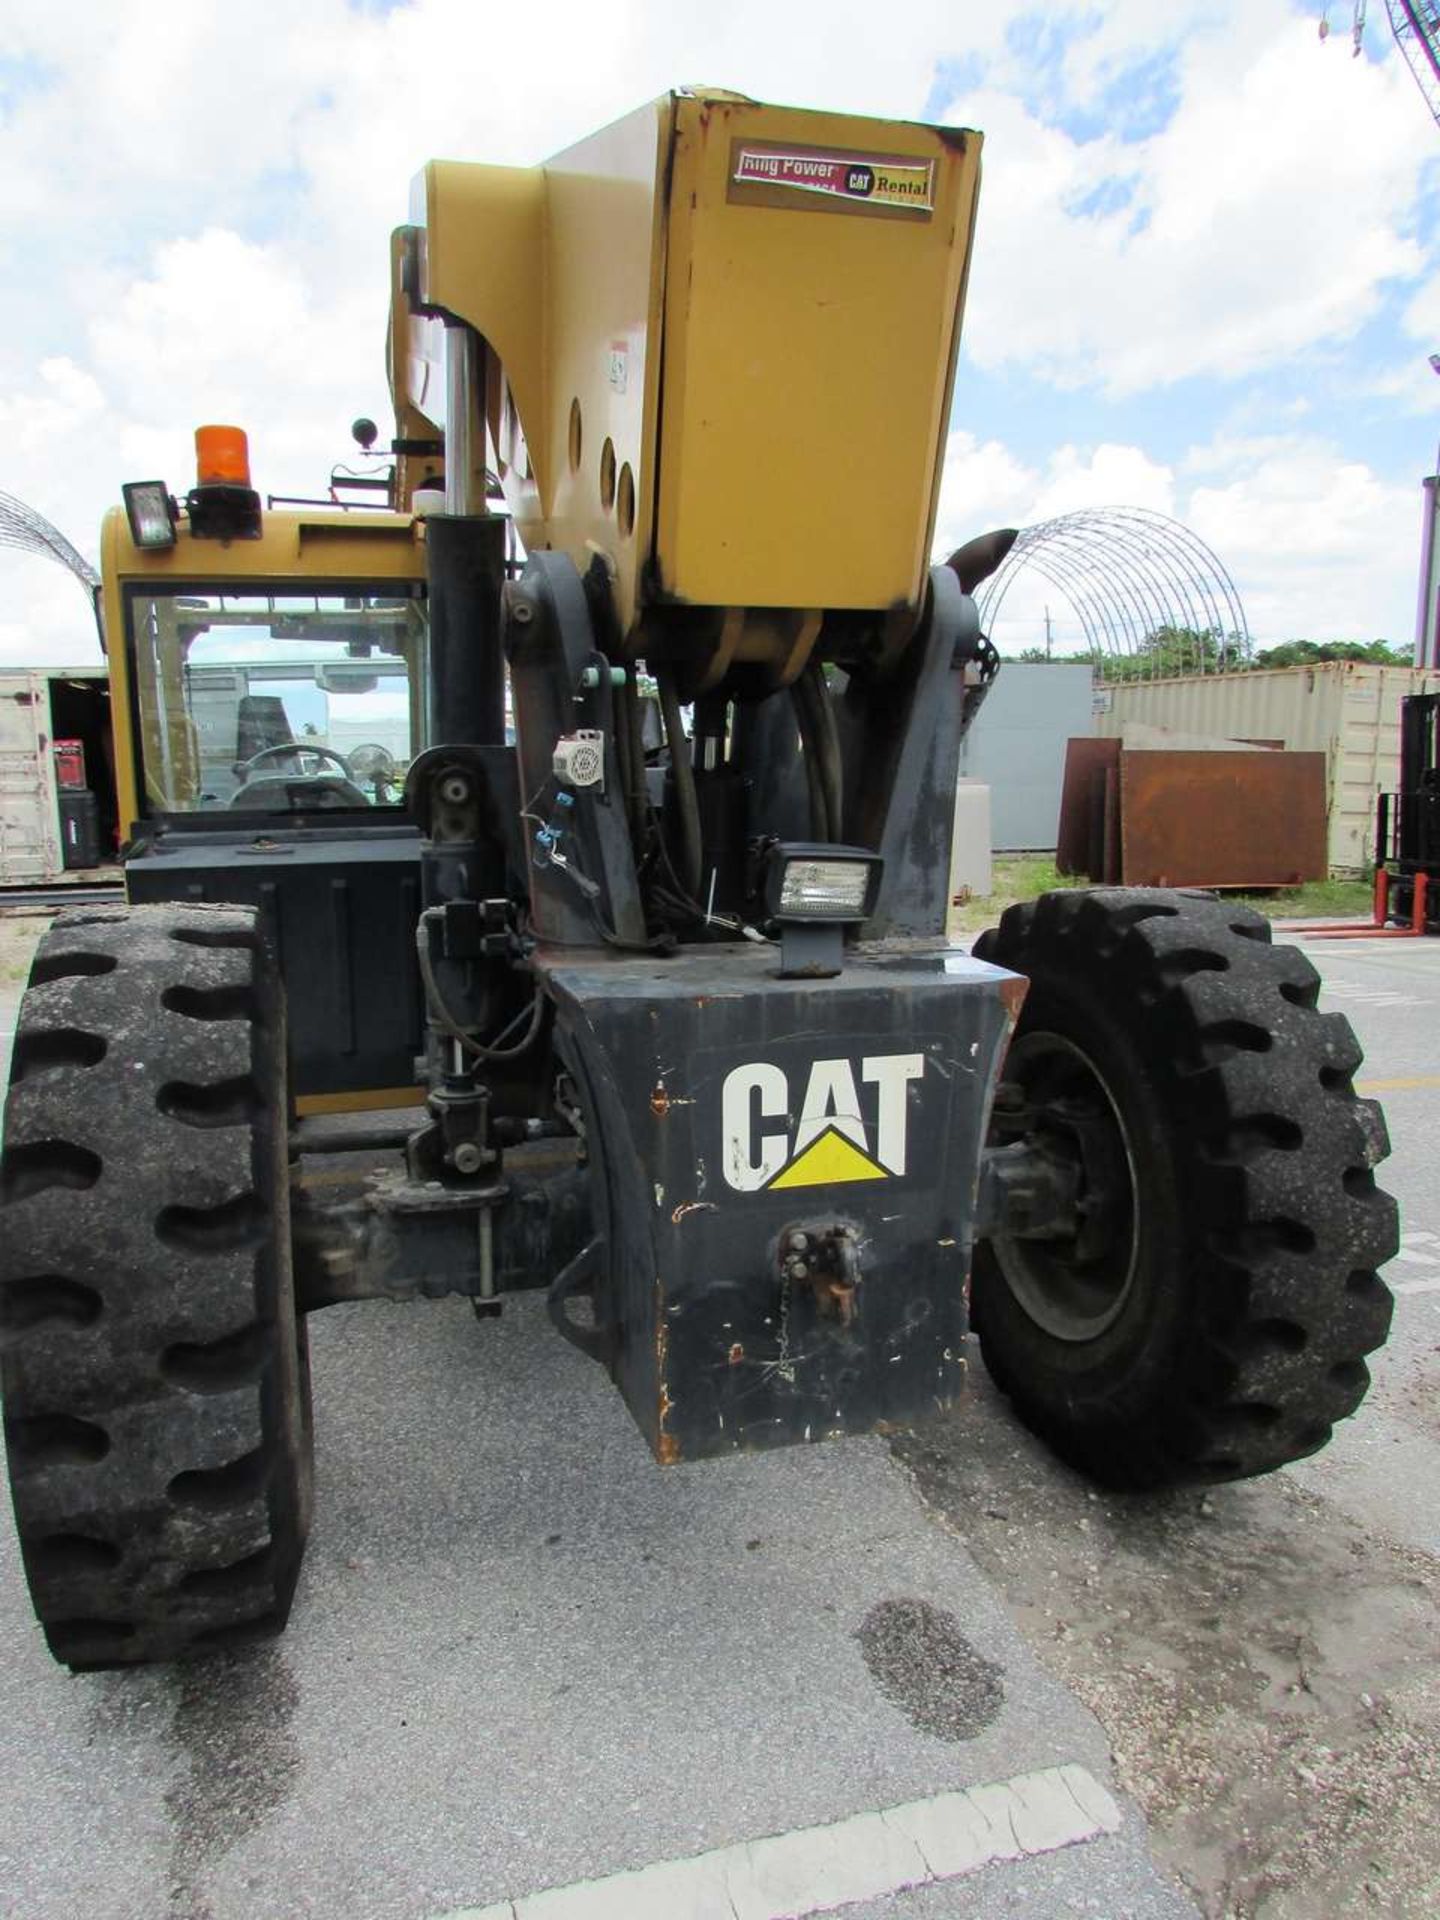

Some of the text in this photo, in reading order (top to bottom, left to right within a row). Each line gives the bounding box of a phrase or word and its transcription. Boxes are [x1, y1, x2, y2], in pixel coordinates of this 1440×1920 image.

[783, 159, 833, 177] Power
[849, 173, 870, 191] CAT
[877, 177, 927, 195] Rental
[722, 1053, 924, 1192] CAT
